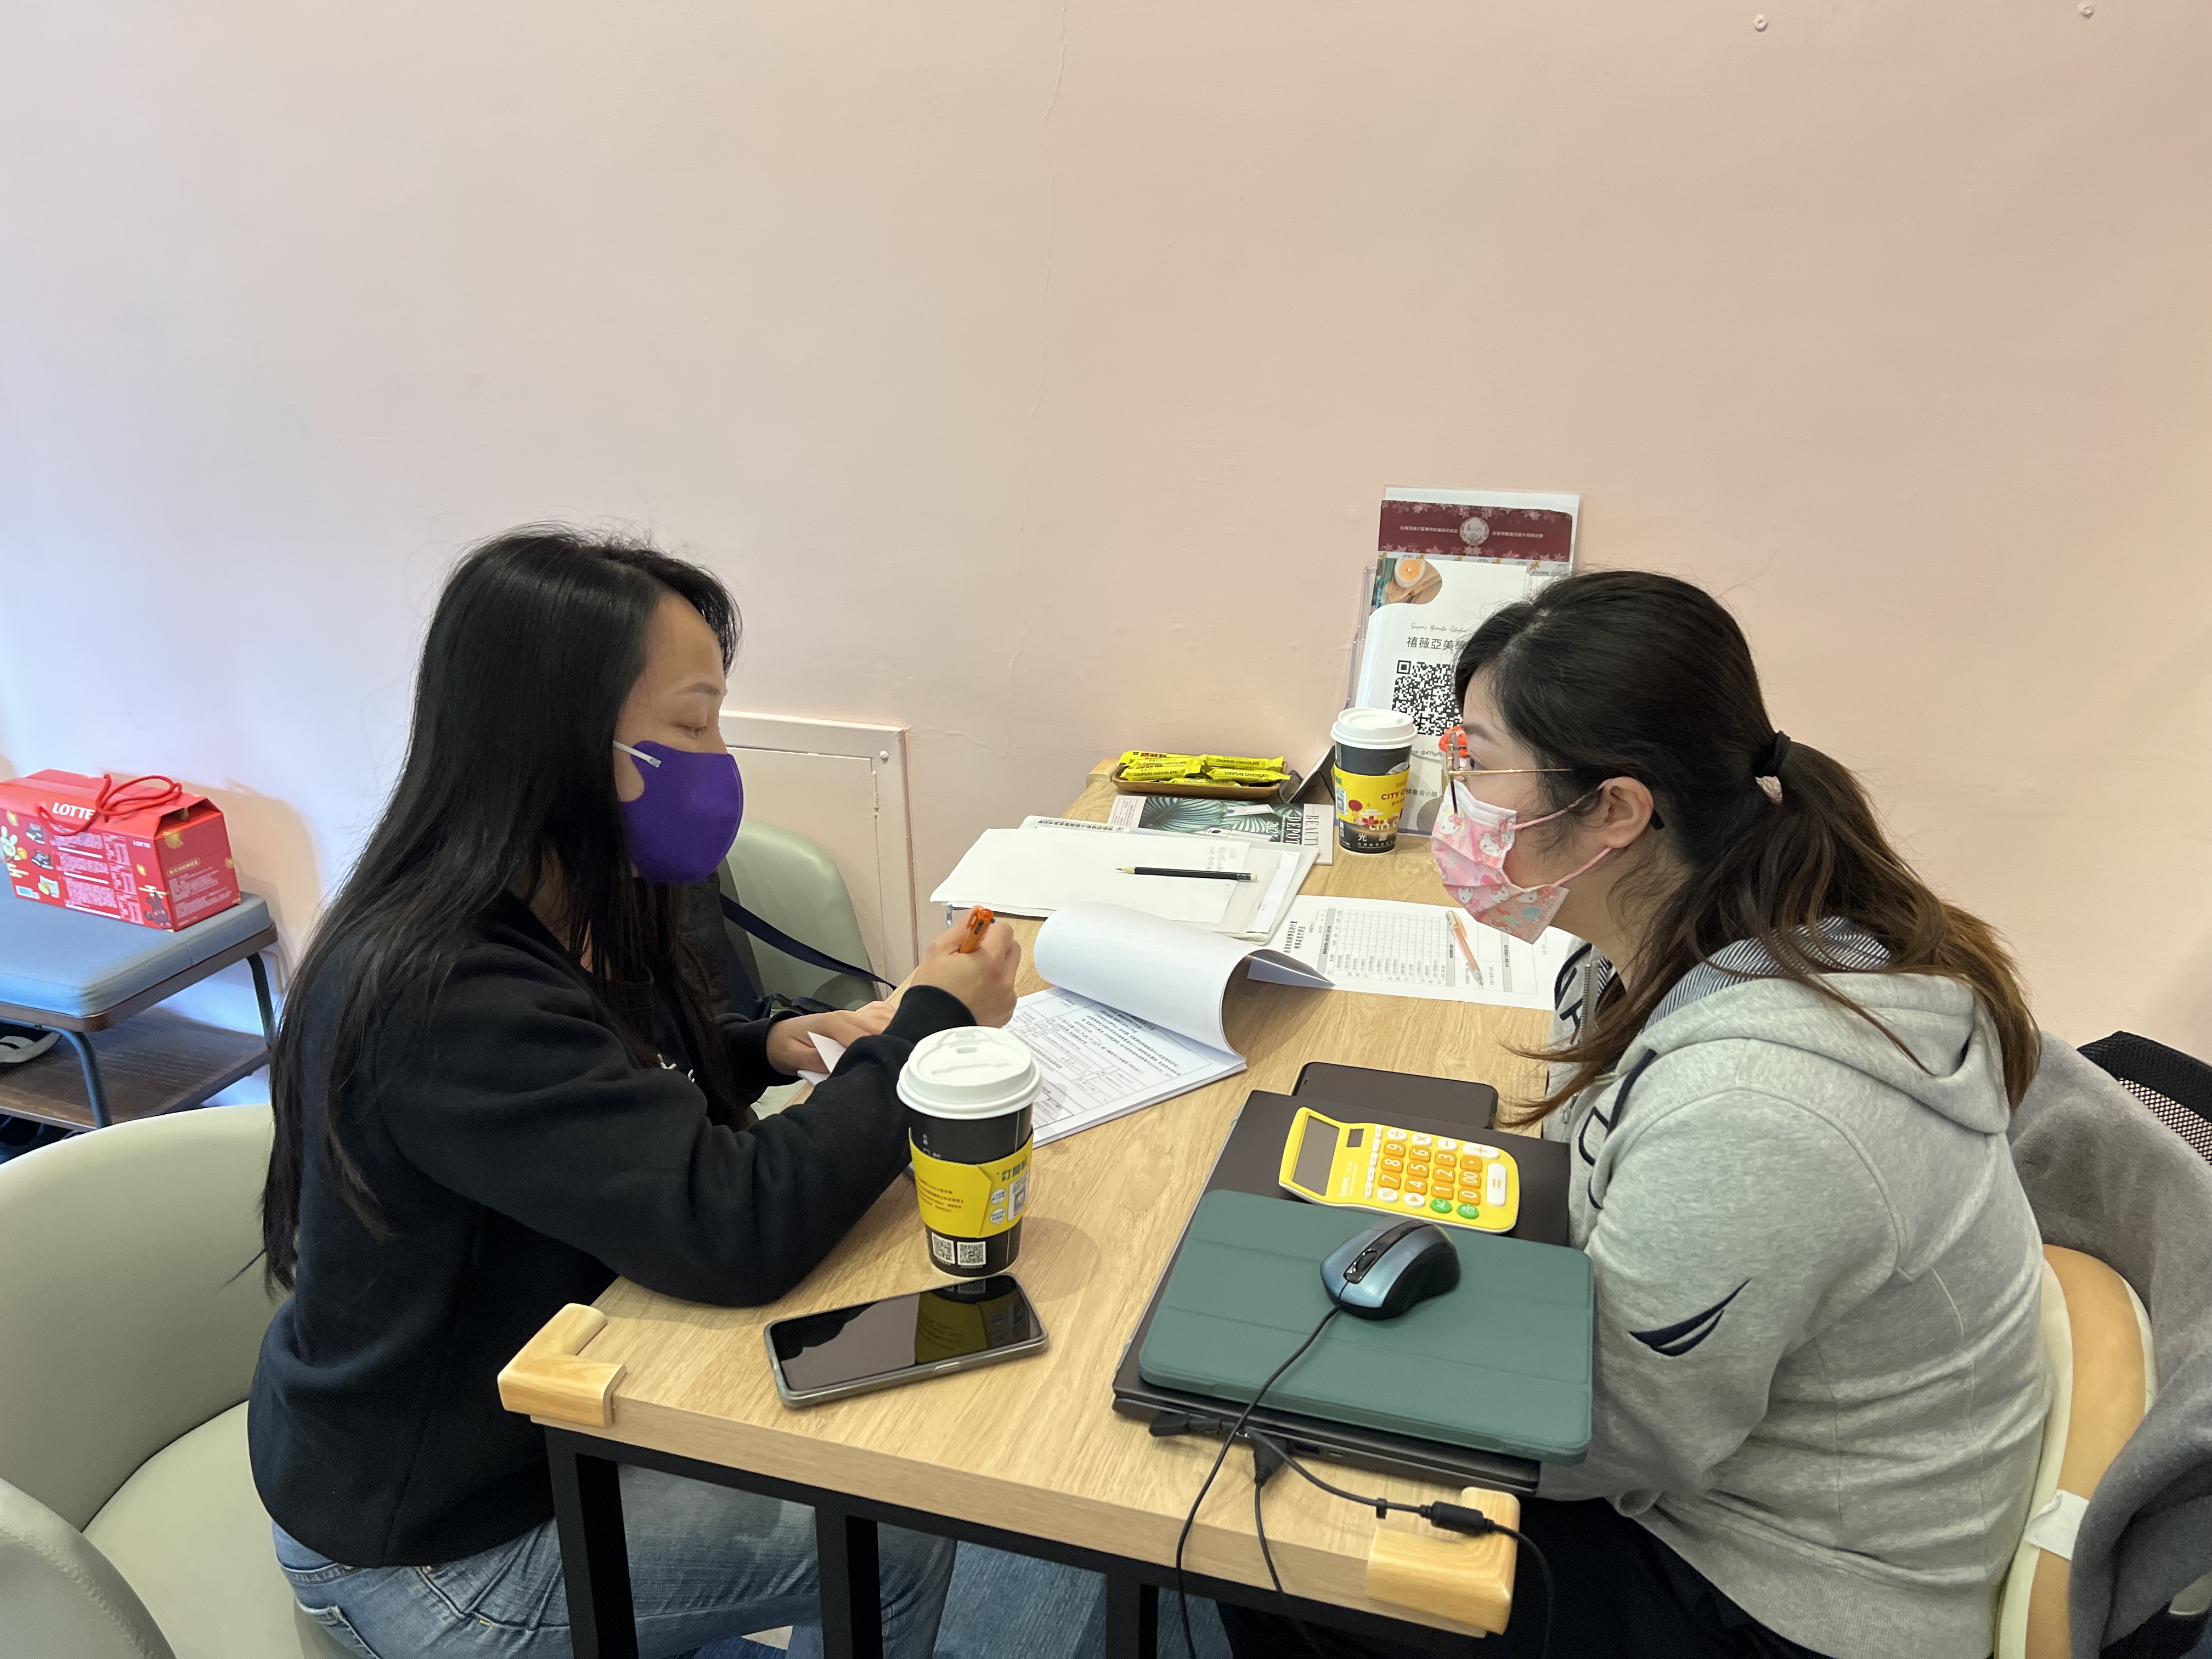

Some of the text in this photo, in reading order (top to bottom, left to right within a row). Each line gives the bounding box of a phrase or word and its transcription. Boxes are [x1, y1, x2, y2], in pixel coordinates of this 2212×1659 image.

[1381, 791, 1400, 800] CITY
[52, 802, 96, 820] LOTTE
[132, 840, 151, 849] LOTTE
[1387, 1143, 1403, 1152] 9
[1413, 1148, 1428, 1156] 6
[1437, 1153, 1453, 1161] 3
[1384, 1158, 1400, 1166] 8
[1410, 1163, 1426, 1172] 5
[1436, 1169, 1452, 1177] 2
[1382, 1174, 1397, 1182] 7
[1462, 1171, 1478, 1184] 00
[1408, 1180, 1425, 1188] 4
[1461, 1190, 1477, 1198] 0
